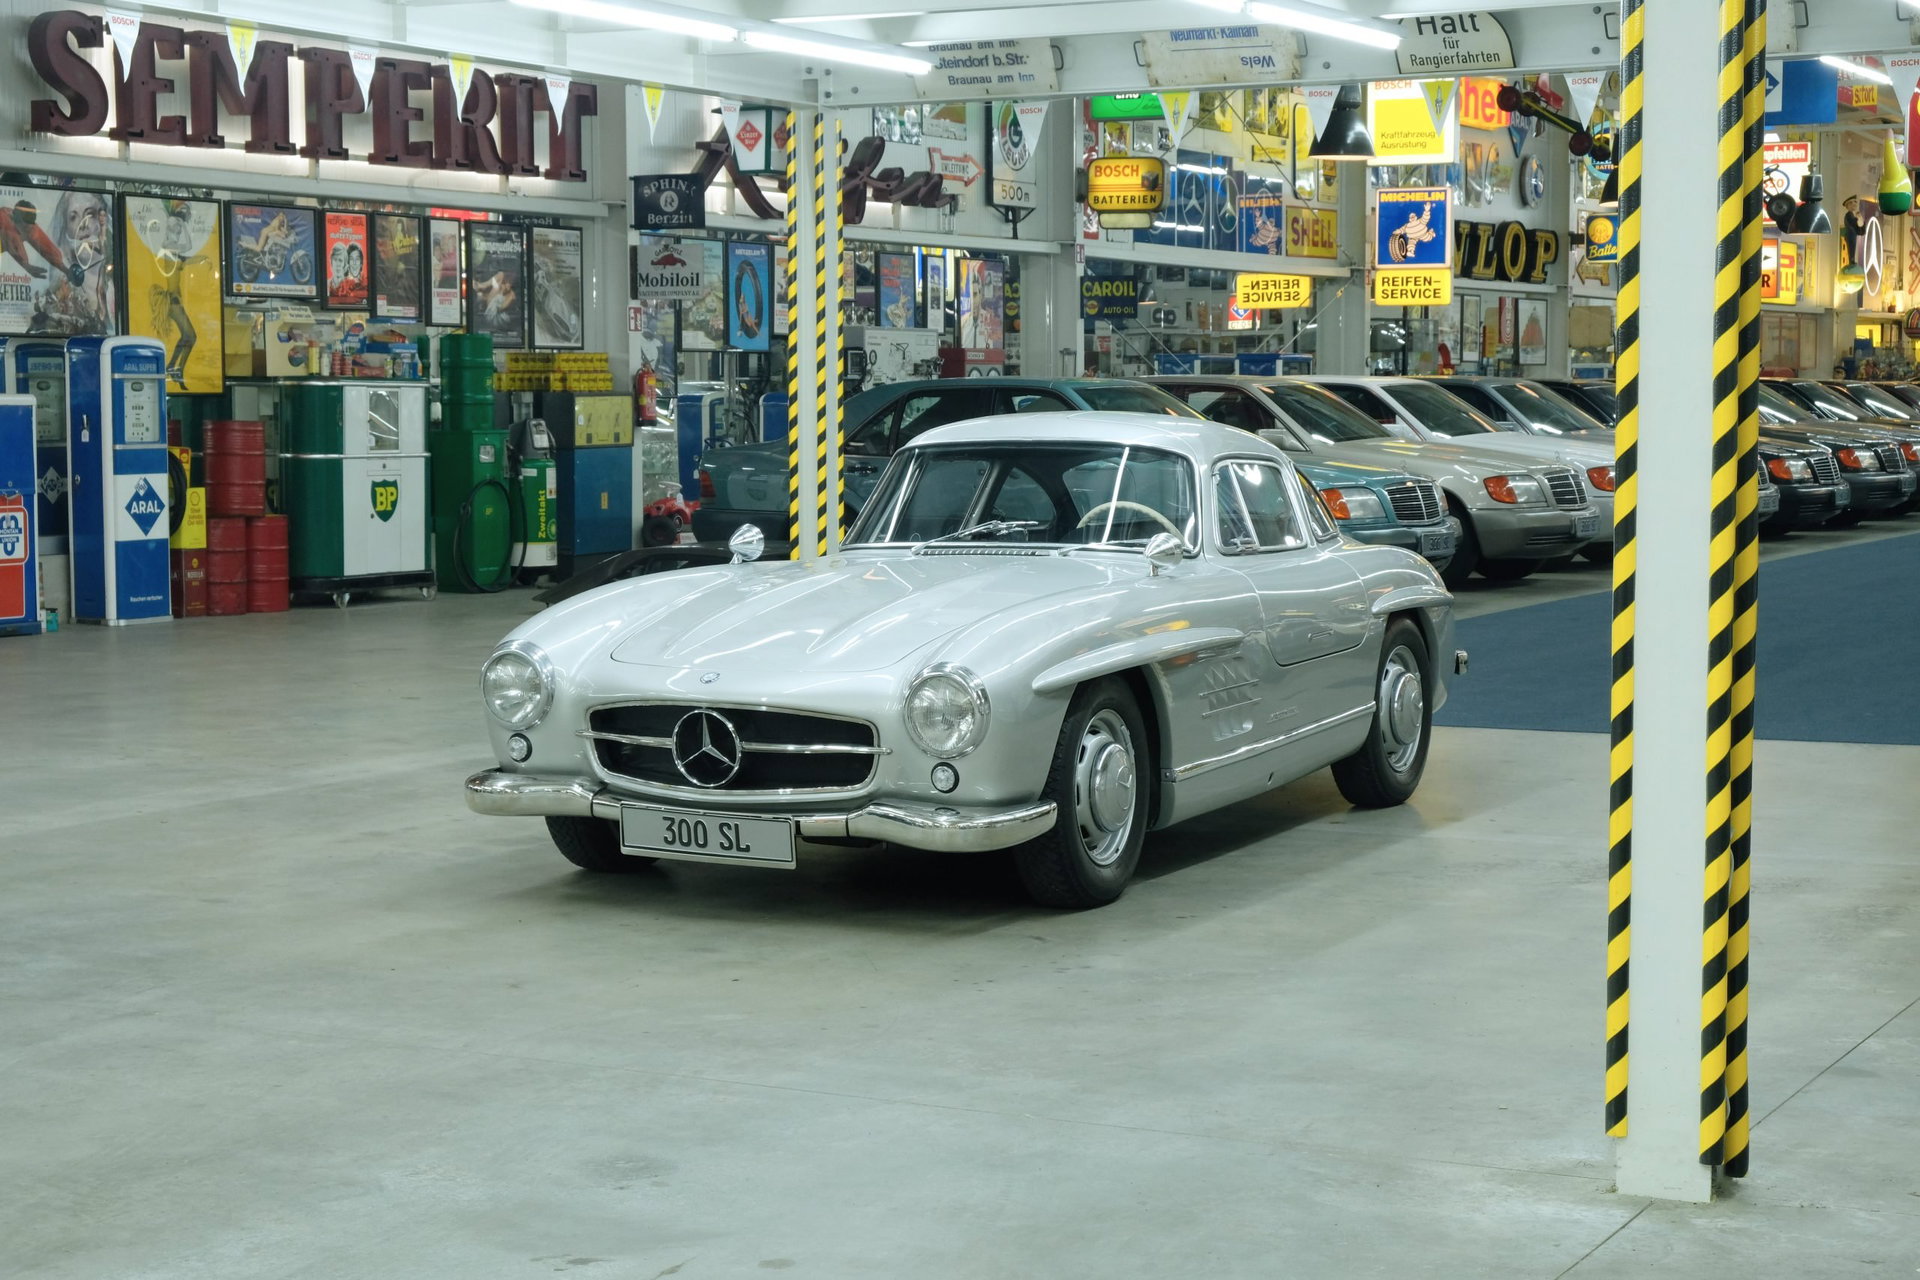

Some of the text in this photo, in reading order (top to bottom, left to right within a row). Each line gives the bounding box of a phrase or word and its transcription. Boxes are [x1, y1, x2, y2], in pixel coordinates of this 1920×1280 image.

[111, 16, 136, 27] BOSCH
[1416, 12, 1480, 35] Halt
[1442, 37, 1460, 50] für
[353, 52, 372, 61] BOSCH
[1240, 55, 1275, 68] Wels
[1410, 51, 1501, 68] Rangierfahrten
[1890, 59, 1920, 67] BOSCH
[549, 80, 566, 89] BOSCH
[947, 72, 1035, 86] Braunau am Inn
[1375, 79, 1412, 90] BOSCH
[28, 10, 598, 182] SEMPERIT
[1020, 107, 1043, 115] BOSCH
[1380, 130, 1436, 139] Kraftfahrzeug
[1094, 164, 1140, 179] BOSCH
[641, 178, 697, 198] SPHIN
[1001, 183, 1023, 200] 500
[1093, 194, 1157, 205] BATTERIEN
[1380, 191, 1446, 202] MICHELIN
[1291, 216, 1334, 249] SHELL
[1588, 243, 1618, 259] Batte
[638, 272, 700, 287] Mobiloil
[1381, 275, 1442, 287] REIFEN-
[1081, 281, 1136, 297] CAROIL
[1381, 287, 1442, 299] SERVICE
[374, 486, 397, 512] BP
[130, 500, 161, 514] ARAL
[538, 490, 546, 539] Zweitakt
[662, 816, 750, 853] 300 SL
